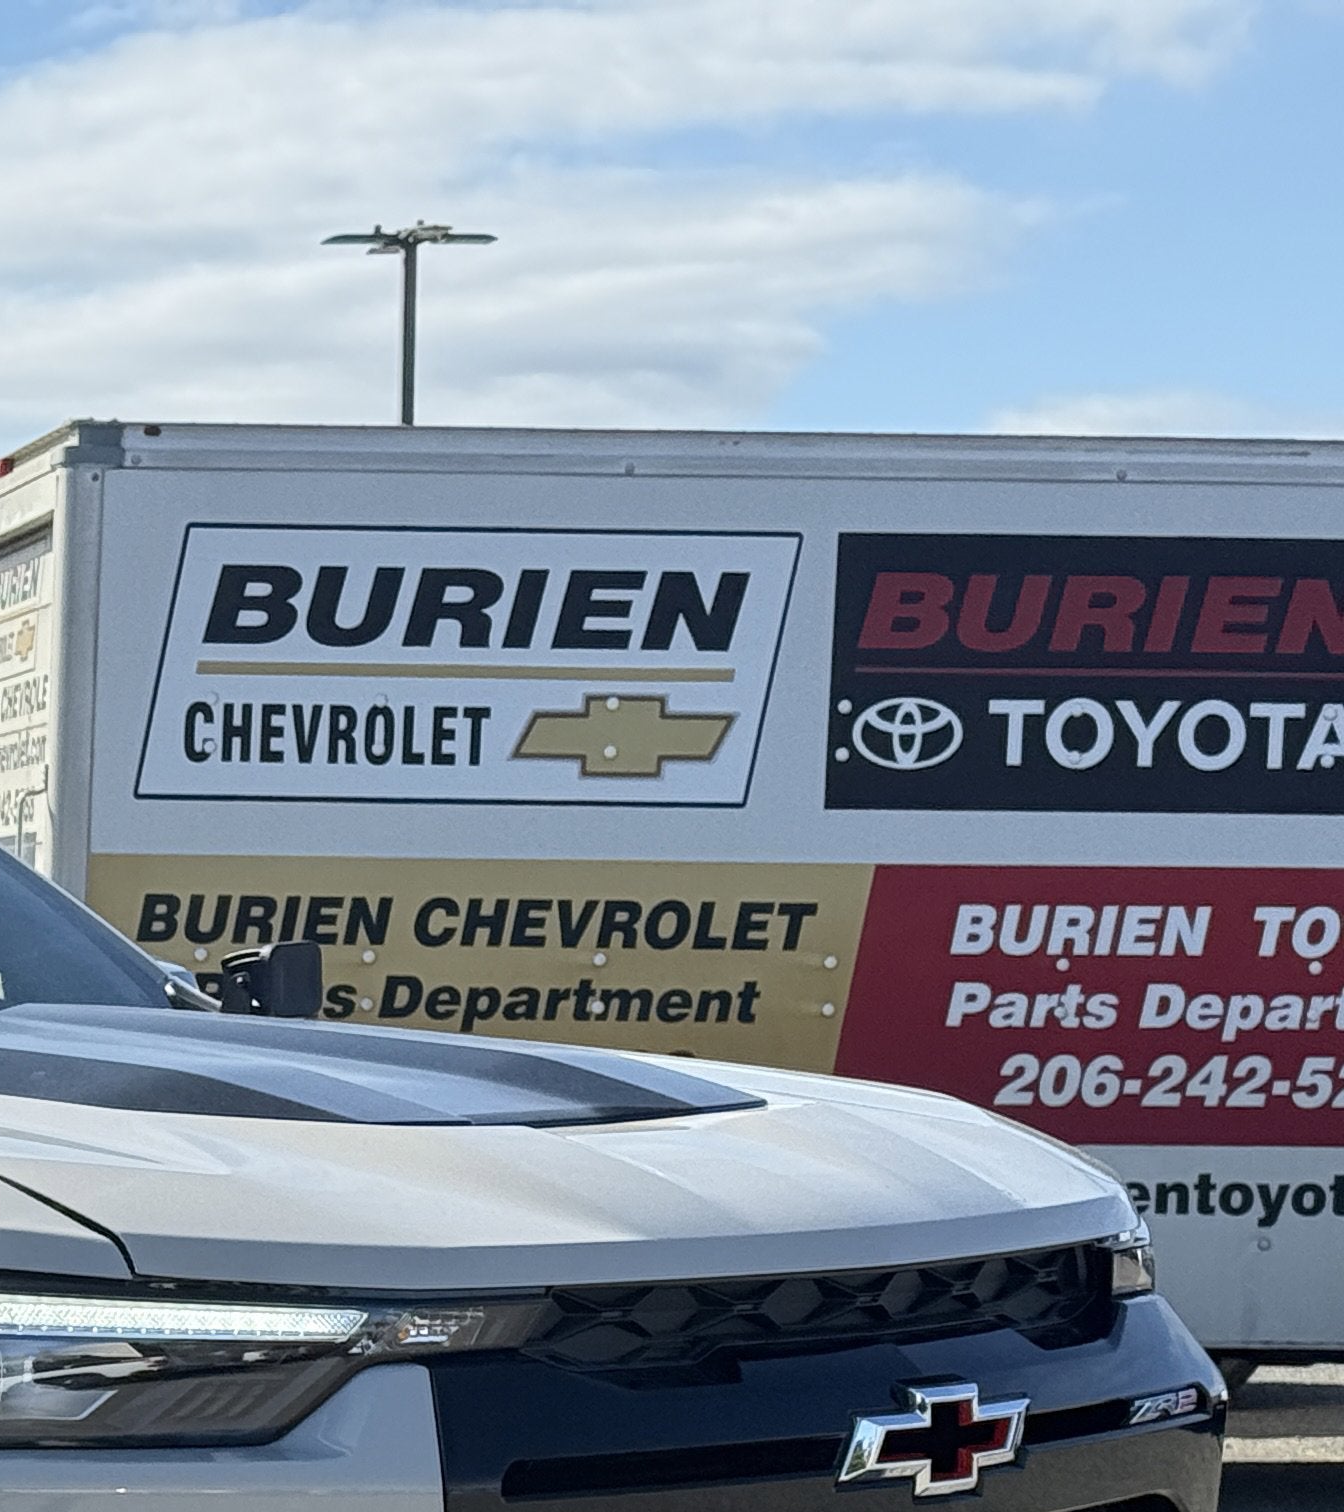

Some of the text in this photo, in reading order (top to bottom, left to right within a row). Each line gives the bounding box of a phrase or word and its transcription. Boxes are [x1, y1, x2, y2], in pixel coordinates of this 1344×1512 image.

[202, 564, 751, 651] BURIEN
[858, 572, 1344, 654] BURIEN
[184, 701, 491, 766] CHEVROLET
[988, 698, 1344, 771] TOYOTA
[136, 894, 818, 950] BURIEN CHEVROLET
[950, 904, 1212, 956] BURIEN
[377, 975, 761, 1033] Department
[945, 981, 1119, 1029] Parts
[993, 1053, 1344, 1109] 206-242-5
[1129, 1387, 1198, 1425] ZR2
